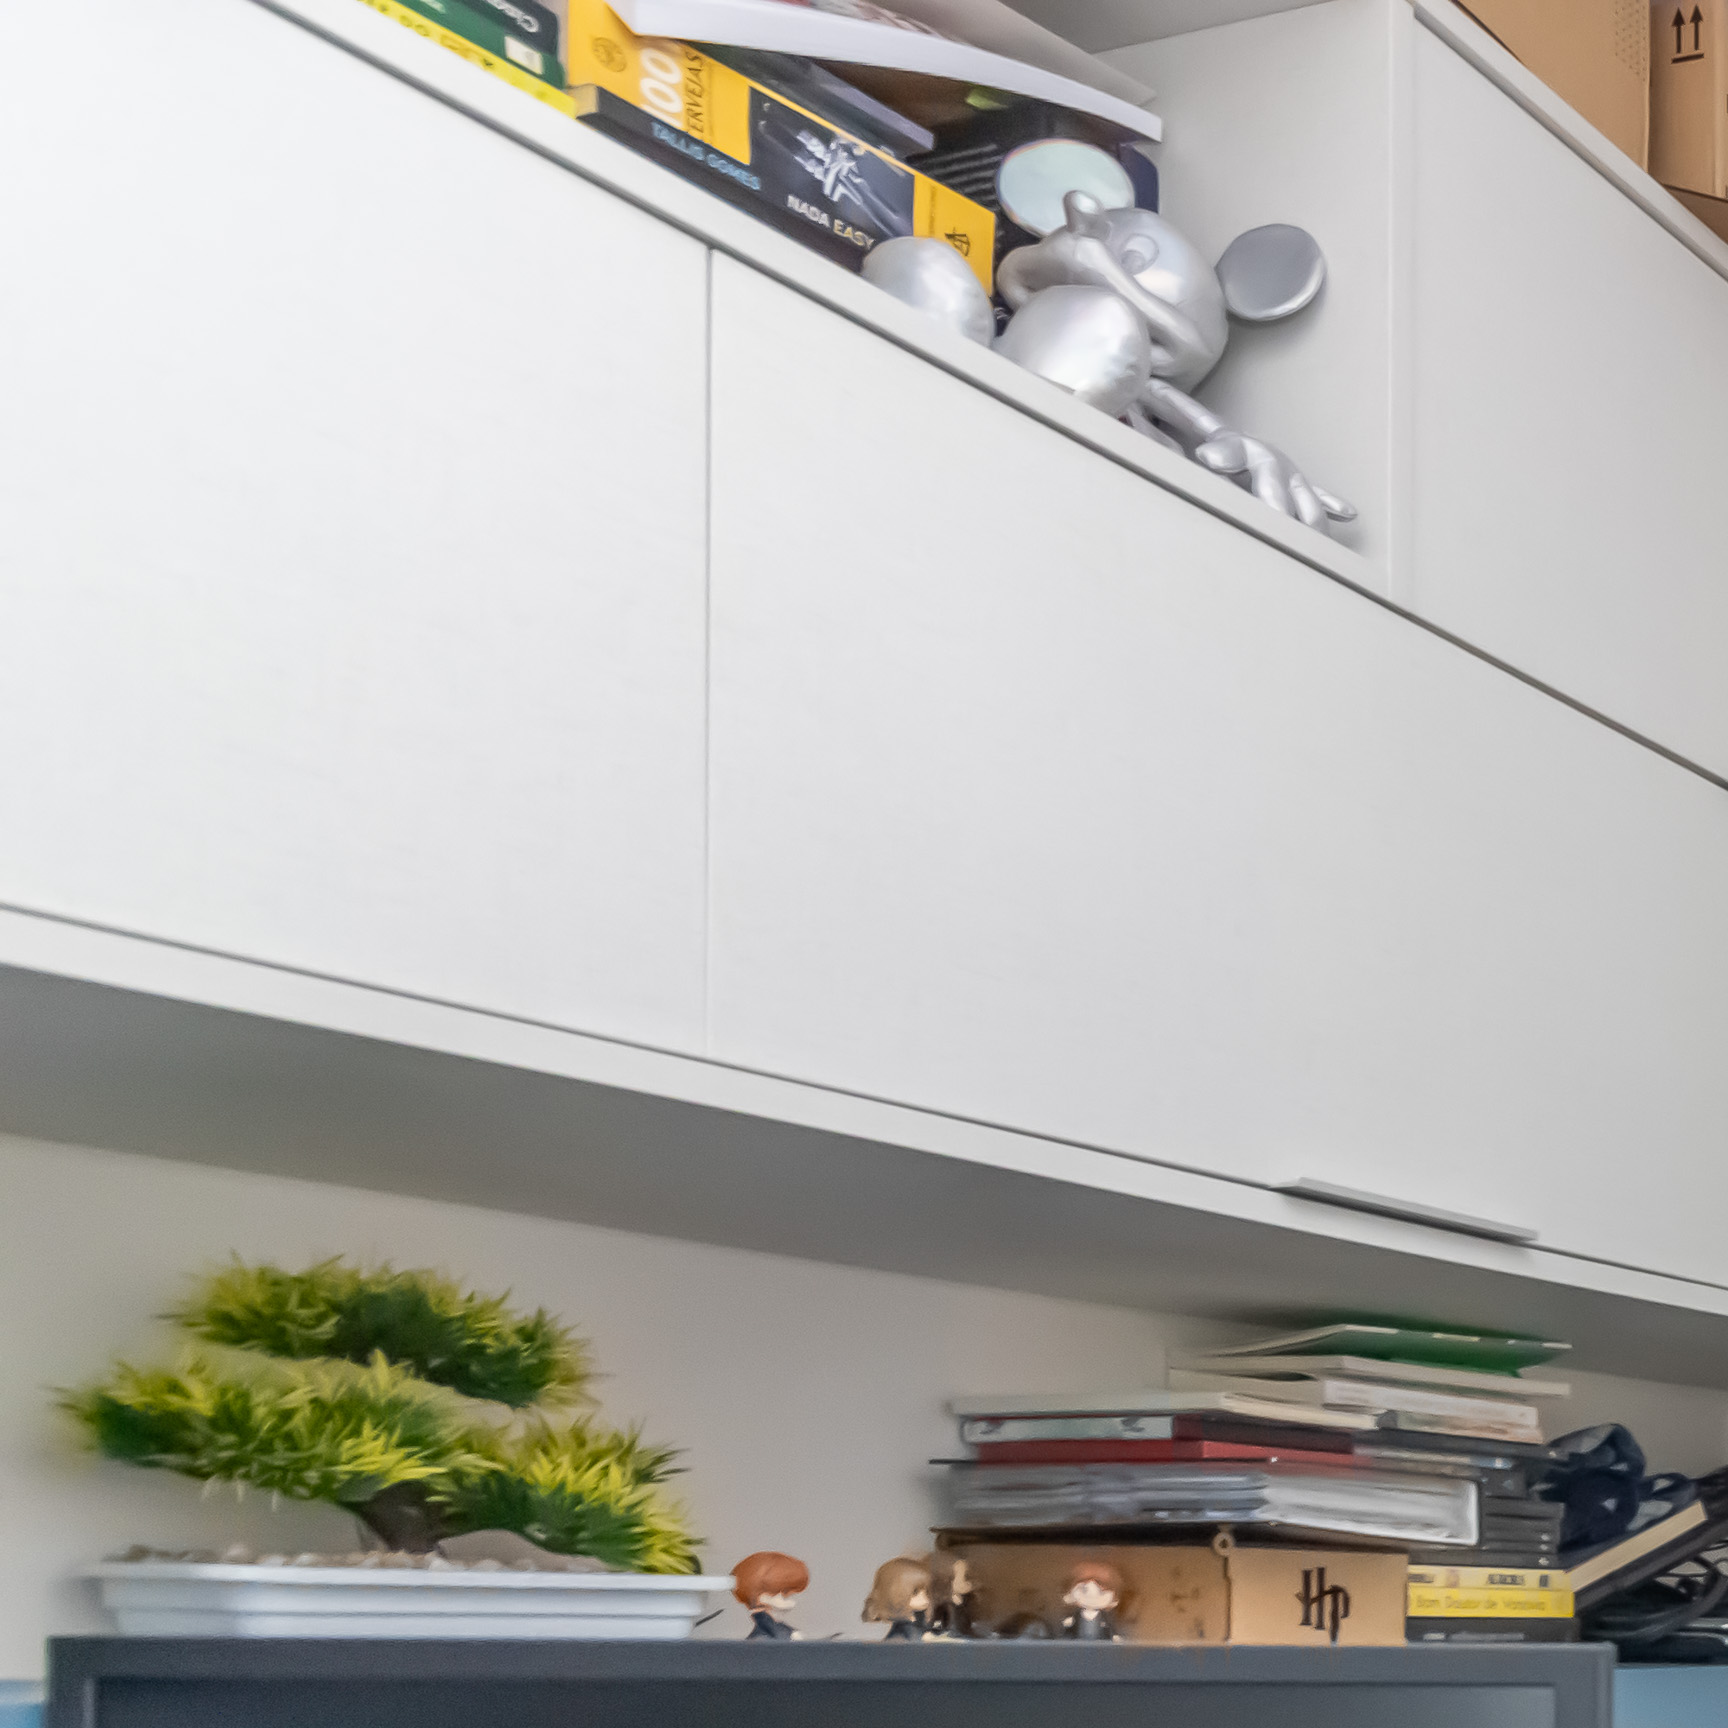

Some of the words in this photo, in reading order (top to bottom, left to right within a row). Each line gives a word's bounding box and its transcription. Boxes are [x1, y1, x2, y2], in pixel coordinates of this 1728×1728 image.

[683, 50, 705, 135] ERVEJAS
[787, 194, 831, 228] NADA
[833, 219, 877, 250] EASY
